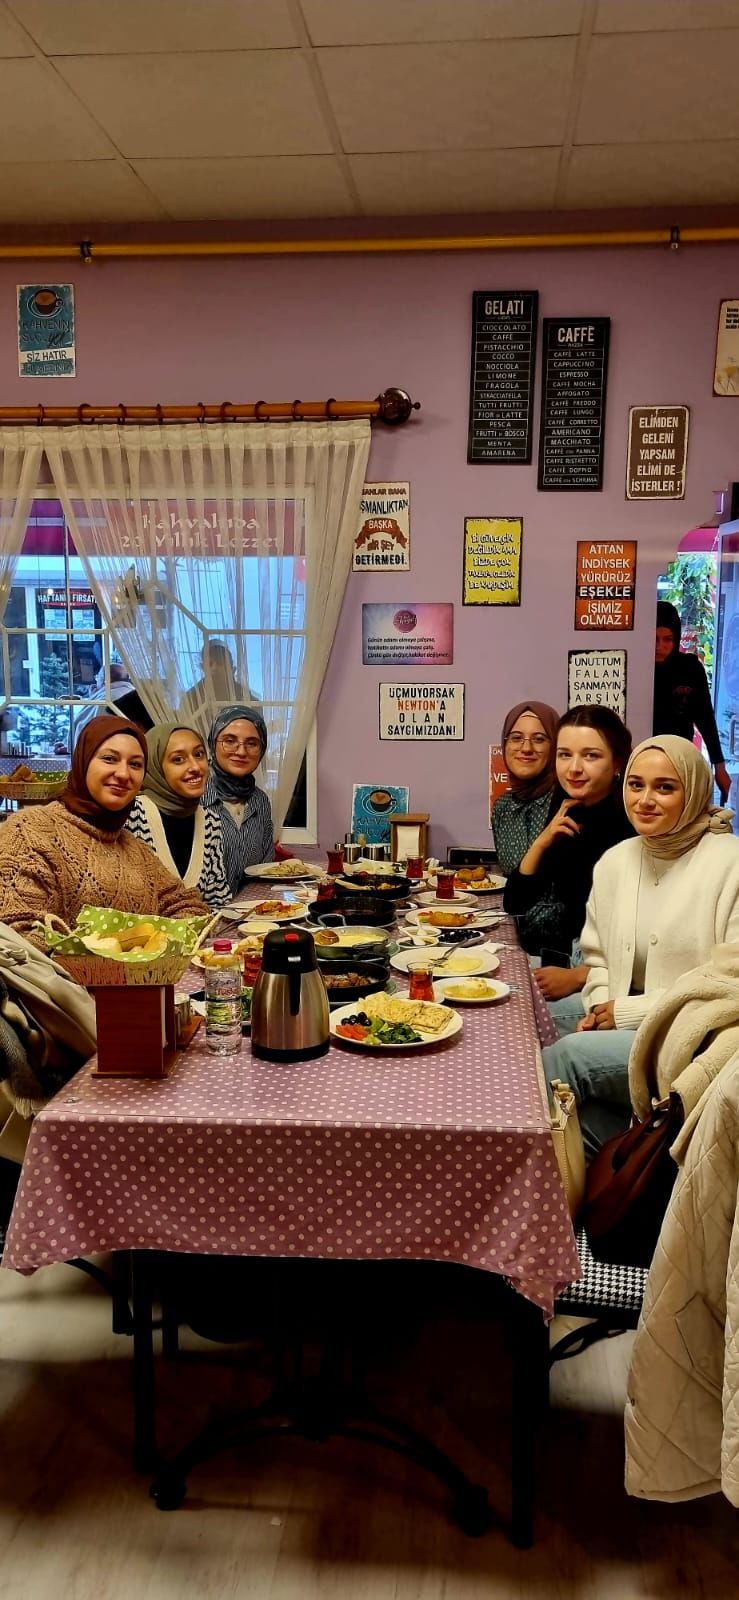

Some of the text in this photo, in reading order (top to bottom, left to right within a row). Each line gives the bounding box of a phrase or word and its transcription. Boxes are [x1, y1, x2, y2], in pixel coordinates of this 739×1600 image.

[485, 300, 524, 315] GELATI
[43, 350, 66, 360] HATIR
[639, 415, 679, 428] ELİMDEN
[642, 430, 674, 444] GELENİ
[640, 449, 675, 460] YAPSAM
[637, 462, 676, 476] ELİMİ DE
[631, 479, 674, 491] İSTERLER
[360, 499, 408, 514] ŞMANLIKTAN
[381, 540, 394, 552] ŞEY
[589, 545, 624, 554] ATTAN
[582, 557, 630, 568] İNDİYSEK
[581, 571, 631, 582] YÜRÜRÜZ
[580, 586, 630, 599] EŞEKLE
[73, 594, 97, 603] FIRSAT
[588, 601, 622, 615] İŞİMİZ
[580, 615, 622, 625] OLMAZ
[575, 658, 621, 666] UNUTTUM
[576, 670, 619, 678] FALAN
[574, 682, 621, 690] SANMAYIN
[576, 692, 619, 704] ARŞİV
[388, 725, 455, 735] SAYGIMIZDAN!
